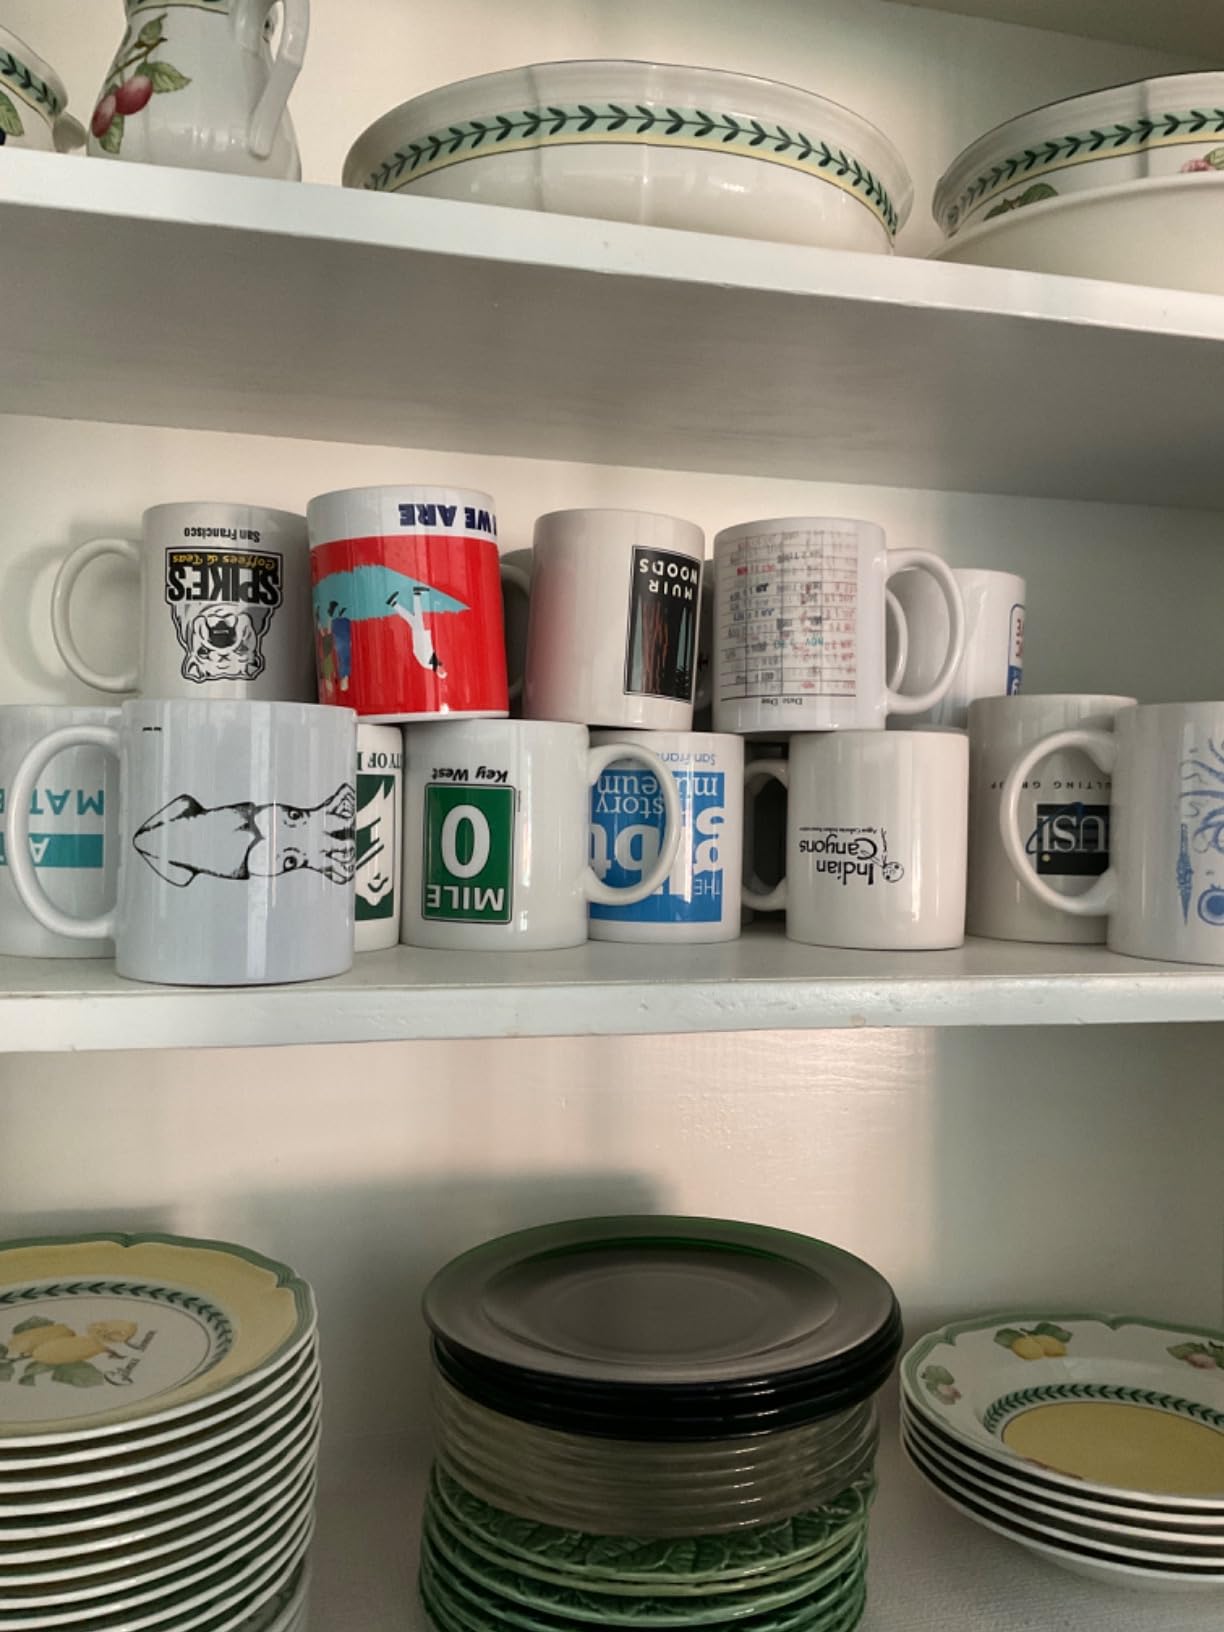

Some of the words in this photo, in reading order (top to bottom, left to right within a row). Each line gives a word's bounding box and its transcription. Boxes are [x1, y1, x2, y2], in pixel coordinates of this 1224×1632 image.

[398, 504, 457, 527] ARE
[184, 527, 237, 540] Francisco
[239, 528, 260, 543] San
[173, 554, 203, 565] Teas
[223, 555, 275, 570] Coffees
[639, 558, 697, 585] WOODS
[168, 565, 280, 606] SPIKE'S
[648, 579, 692, 600] MUIR
[432, 767, 469, 782] West
[475, 766, 508, 783] Key
[441, 804, 490, 878] 0
[799, 833, 877, 860] Canyons
[816, 860, 874, 885] Indian
[427, 884, 505, 911] MILE
[694, 879, 720, 895] THE
